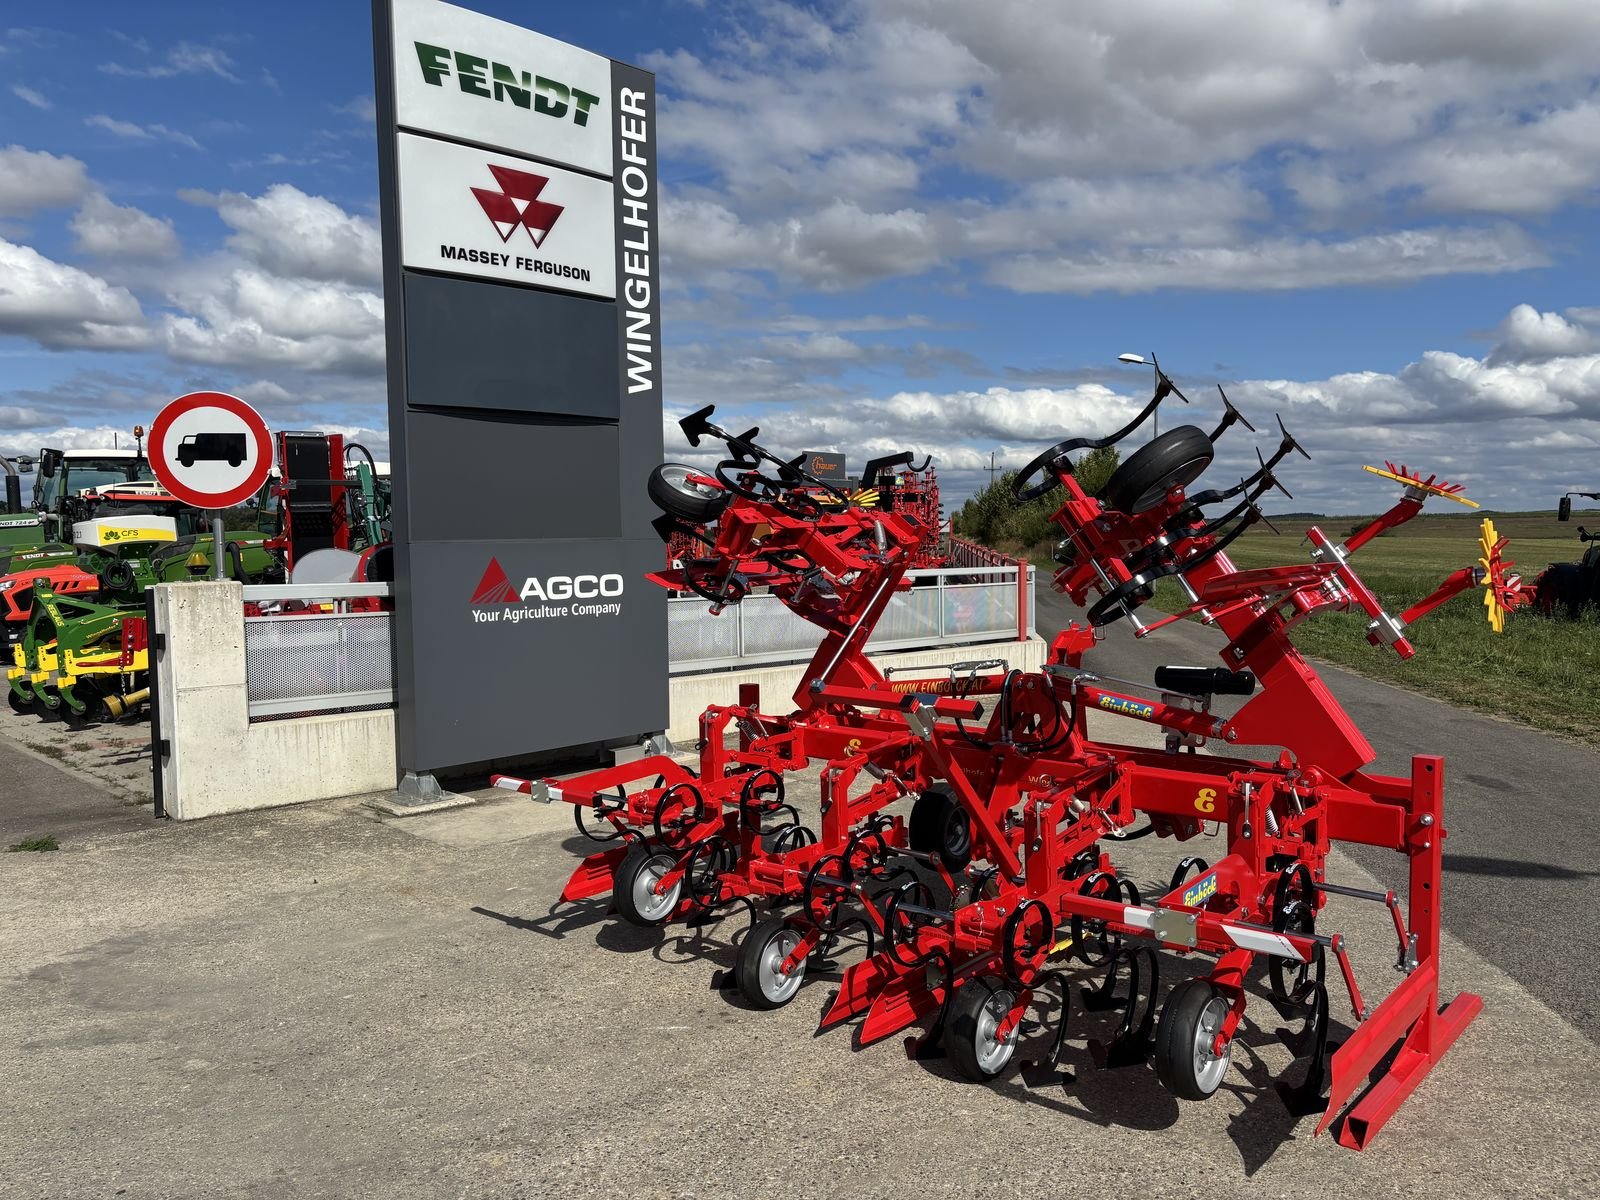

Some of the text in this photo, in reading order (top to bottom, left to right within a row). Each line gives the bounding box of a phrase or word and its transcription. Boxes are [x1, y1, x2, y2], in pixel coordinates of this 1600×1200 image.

[414, 41, 600, 127] FENDT
[620, 87, 653, 394] WINGELHOFER
[440, 244, 591, 282] MASSEY FERGUSON
[520, 574, 623, 601] AGCO
[472, 603, 621, 623] Your Agriculture Company
[1100, 696, 1152, 718] Einböck
[1194, 788, 1217, 813] E
[1184, 875, 1216, 907] Einböck
